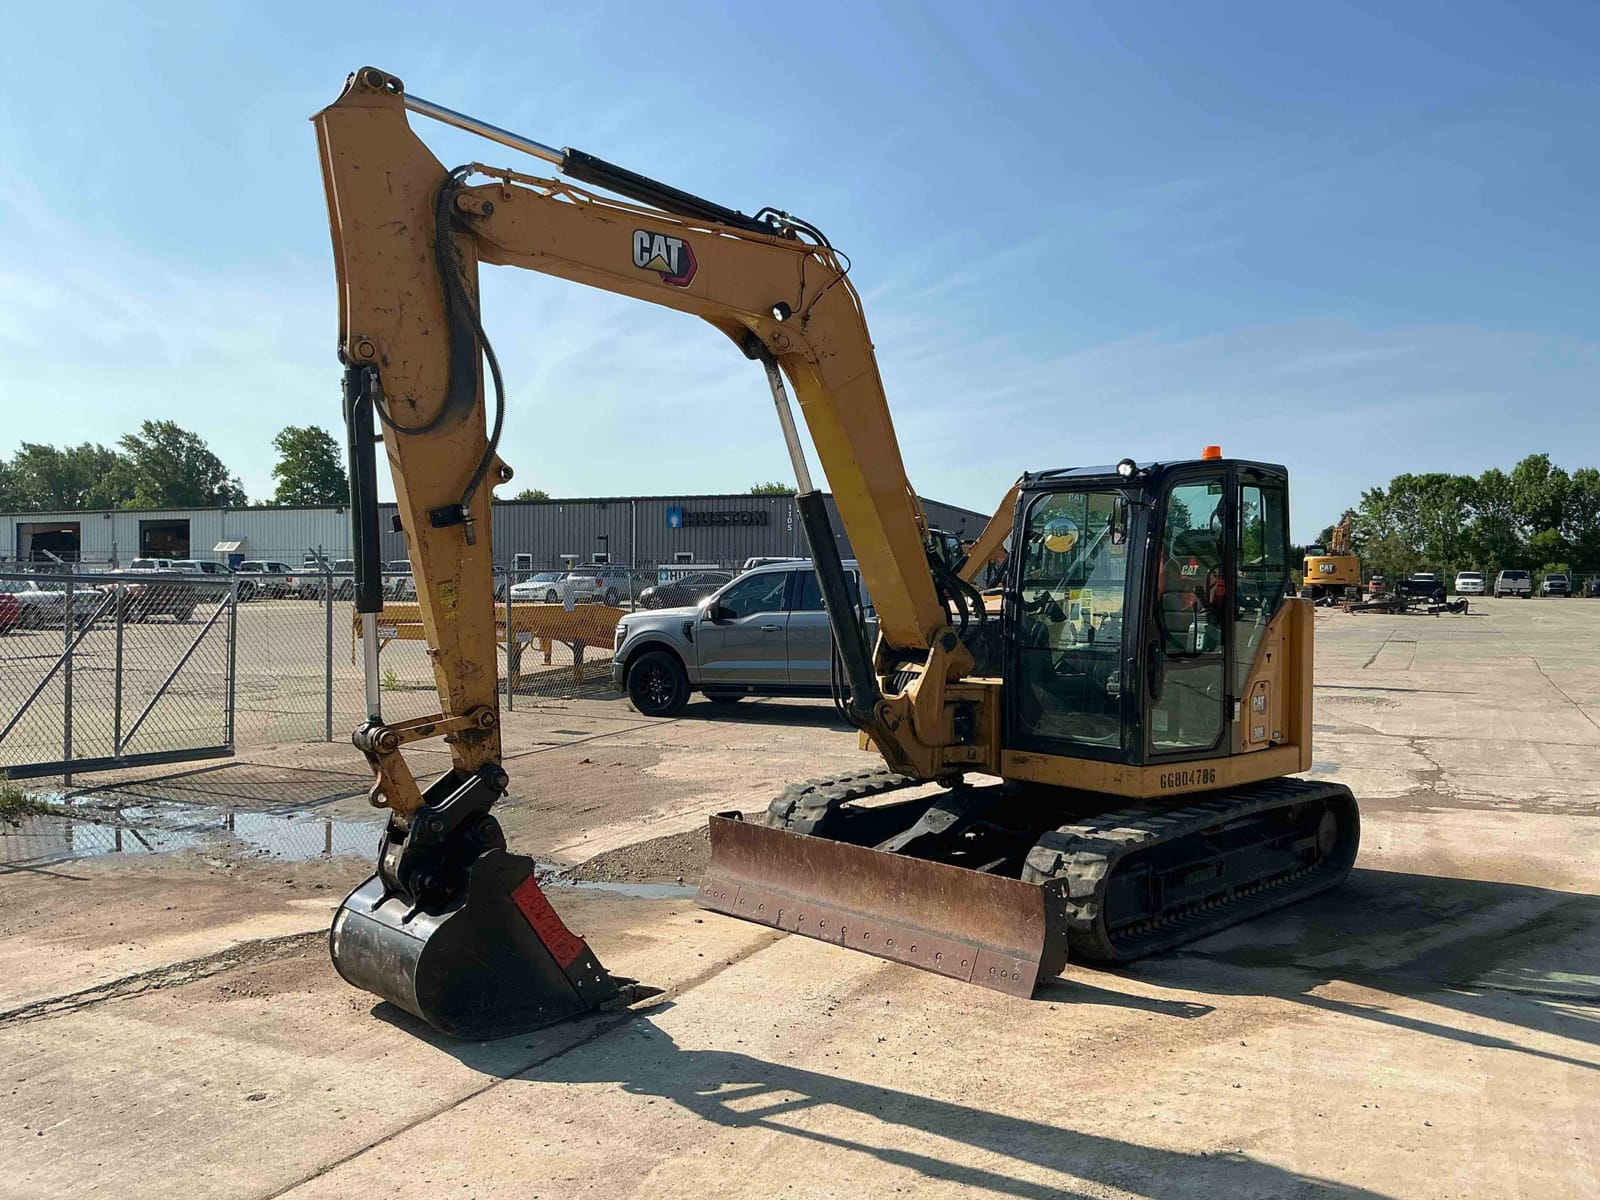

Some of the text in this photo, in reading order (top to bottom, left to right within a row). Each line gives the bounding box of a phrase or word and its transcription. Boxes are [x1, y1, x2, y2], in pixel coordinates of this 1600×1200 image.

[633, 230, 683, 275] CAT
[684, 510, 767, 527] HUSTON
[1181, 564, 1199, 576] CAT
[1319, 564, 1334, 573] CAT
[1253, 695, 1265, 712] CAT
[1160, 768, 1216, 789] GG804786
